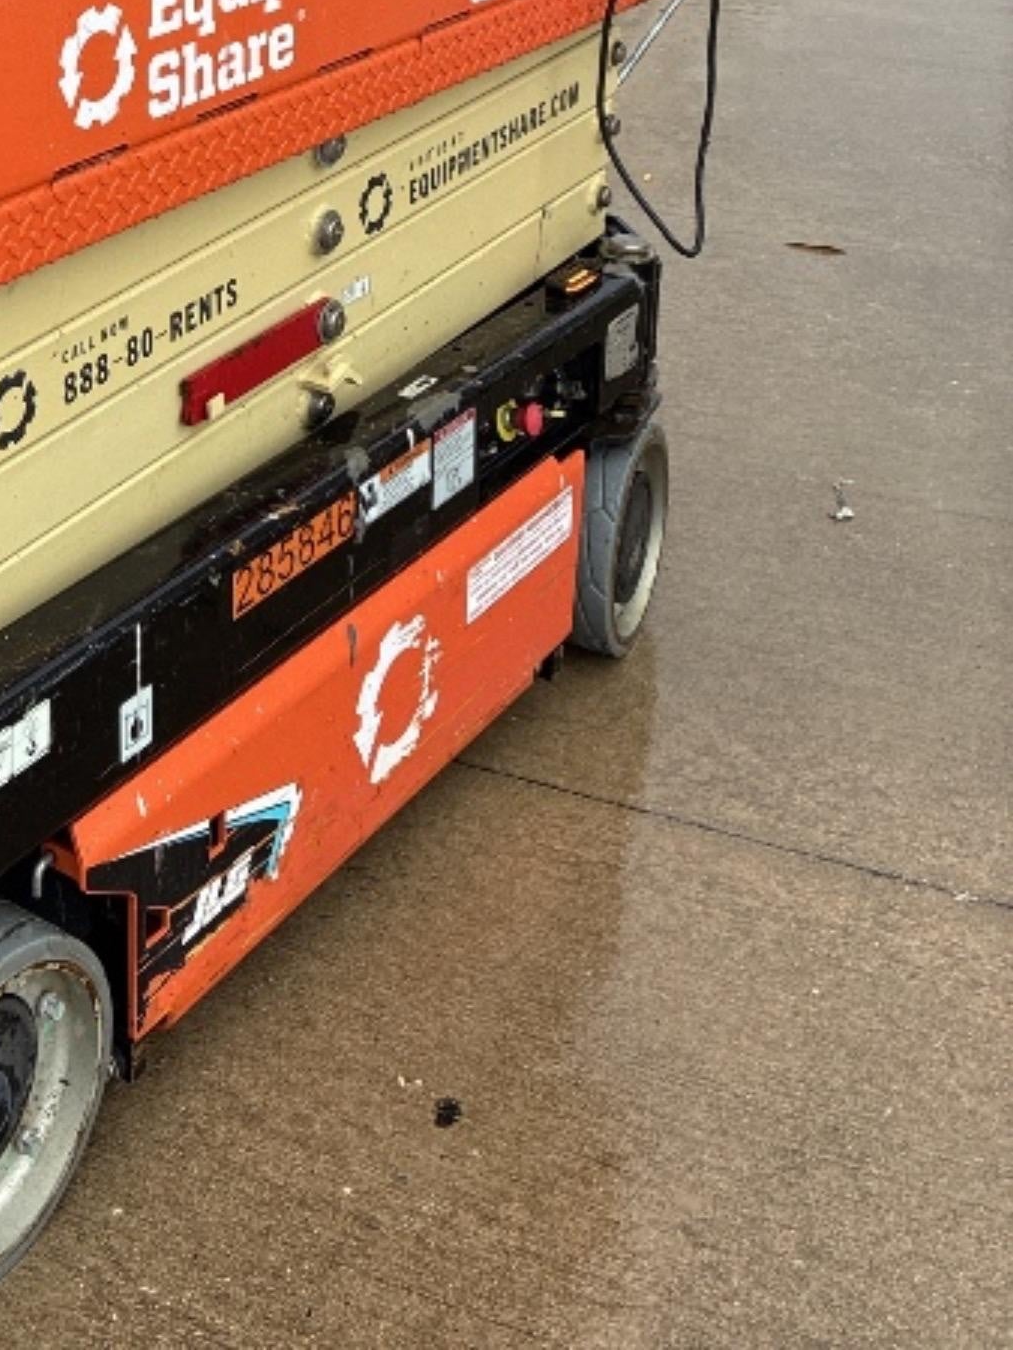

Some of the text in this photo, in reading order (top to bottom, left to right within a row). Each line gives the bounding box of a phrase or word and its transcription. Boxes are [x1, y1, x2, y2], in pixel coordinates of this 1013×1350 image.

[148, 22, 295, 119] Share
[64, 278, 238, 406] 888-80-RENTS
[236, 492, 355, 614] 285846
